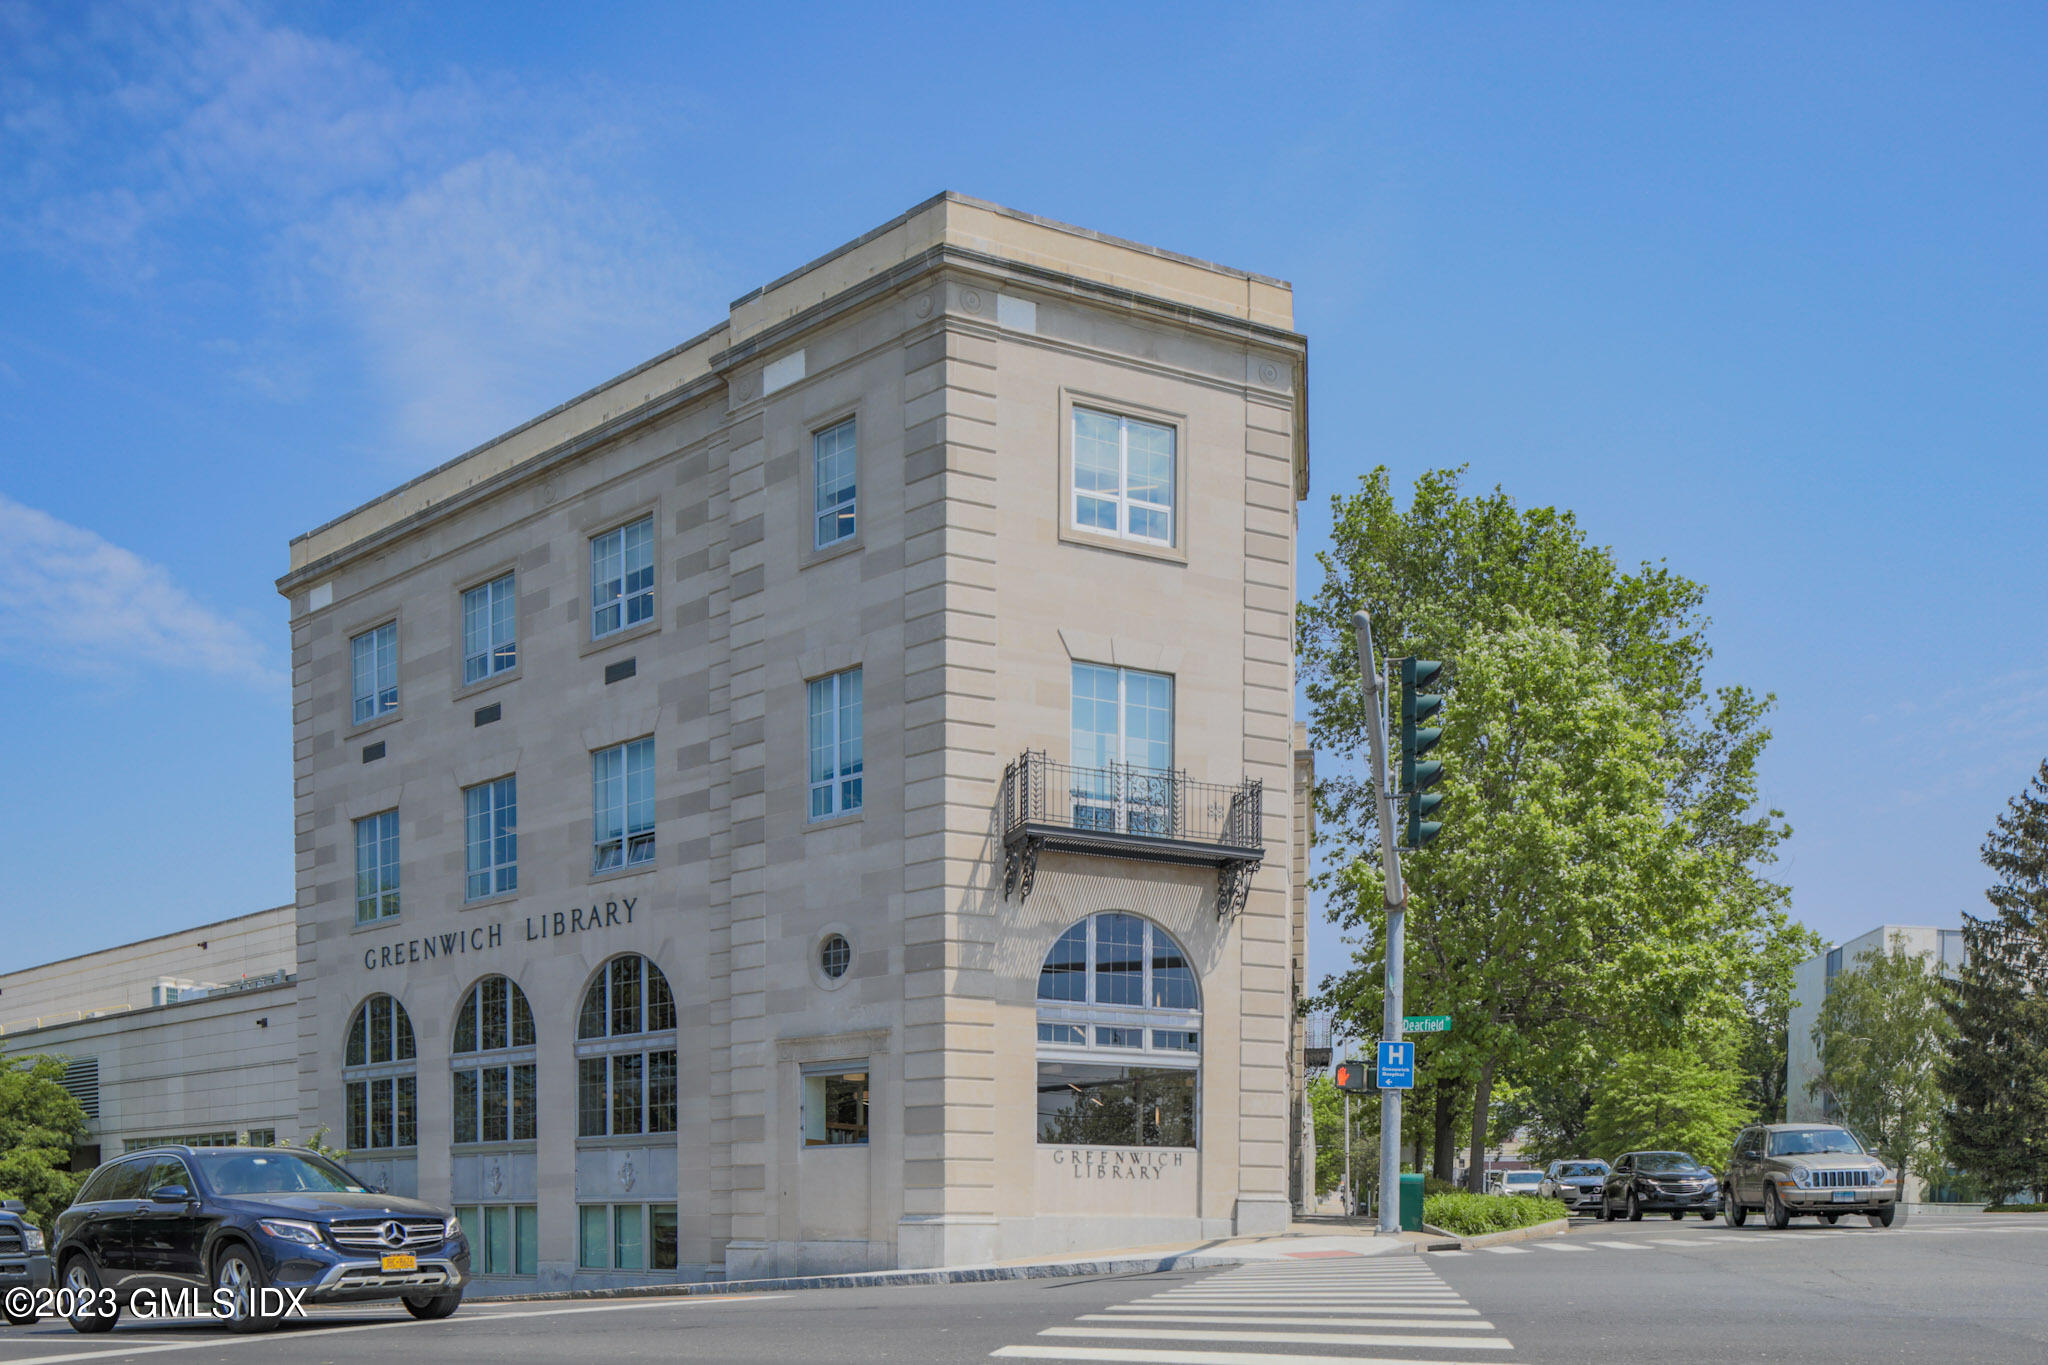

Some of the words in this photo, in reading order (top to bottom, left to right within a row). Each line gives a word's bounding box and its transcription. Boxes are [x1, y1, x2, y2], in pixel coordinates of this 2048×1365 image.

[364, 923, 502, 970] GREENWICH
[526, 897, 638, 941] LIBRARY
[1403, 1019, 1444, 1032] Dearfield
[1388, 1045, 1404, 1065] H
[1053, 1150, 1183, 1167] GREENWICH
[1074, 1165, 1163, 1180] LIBRARY
